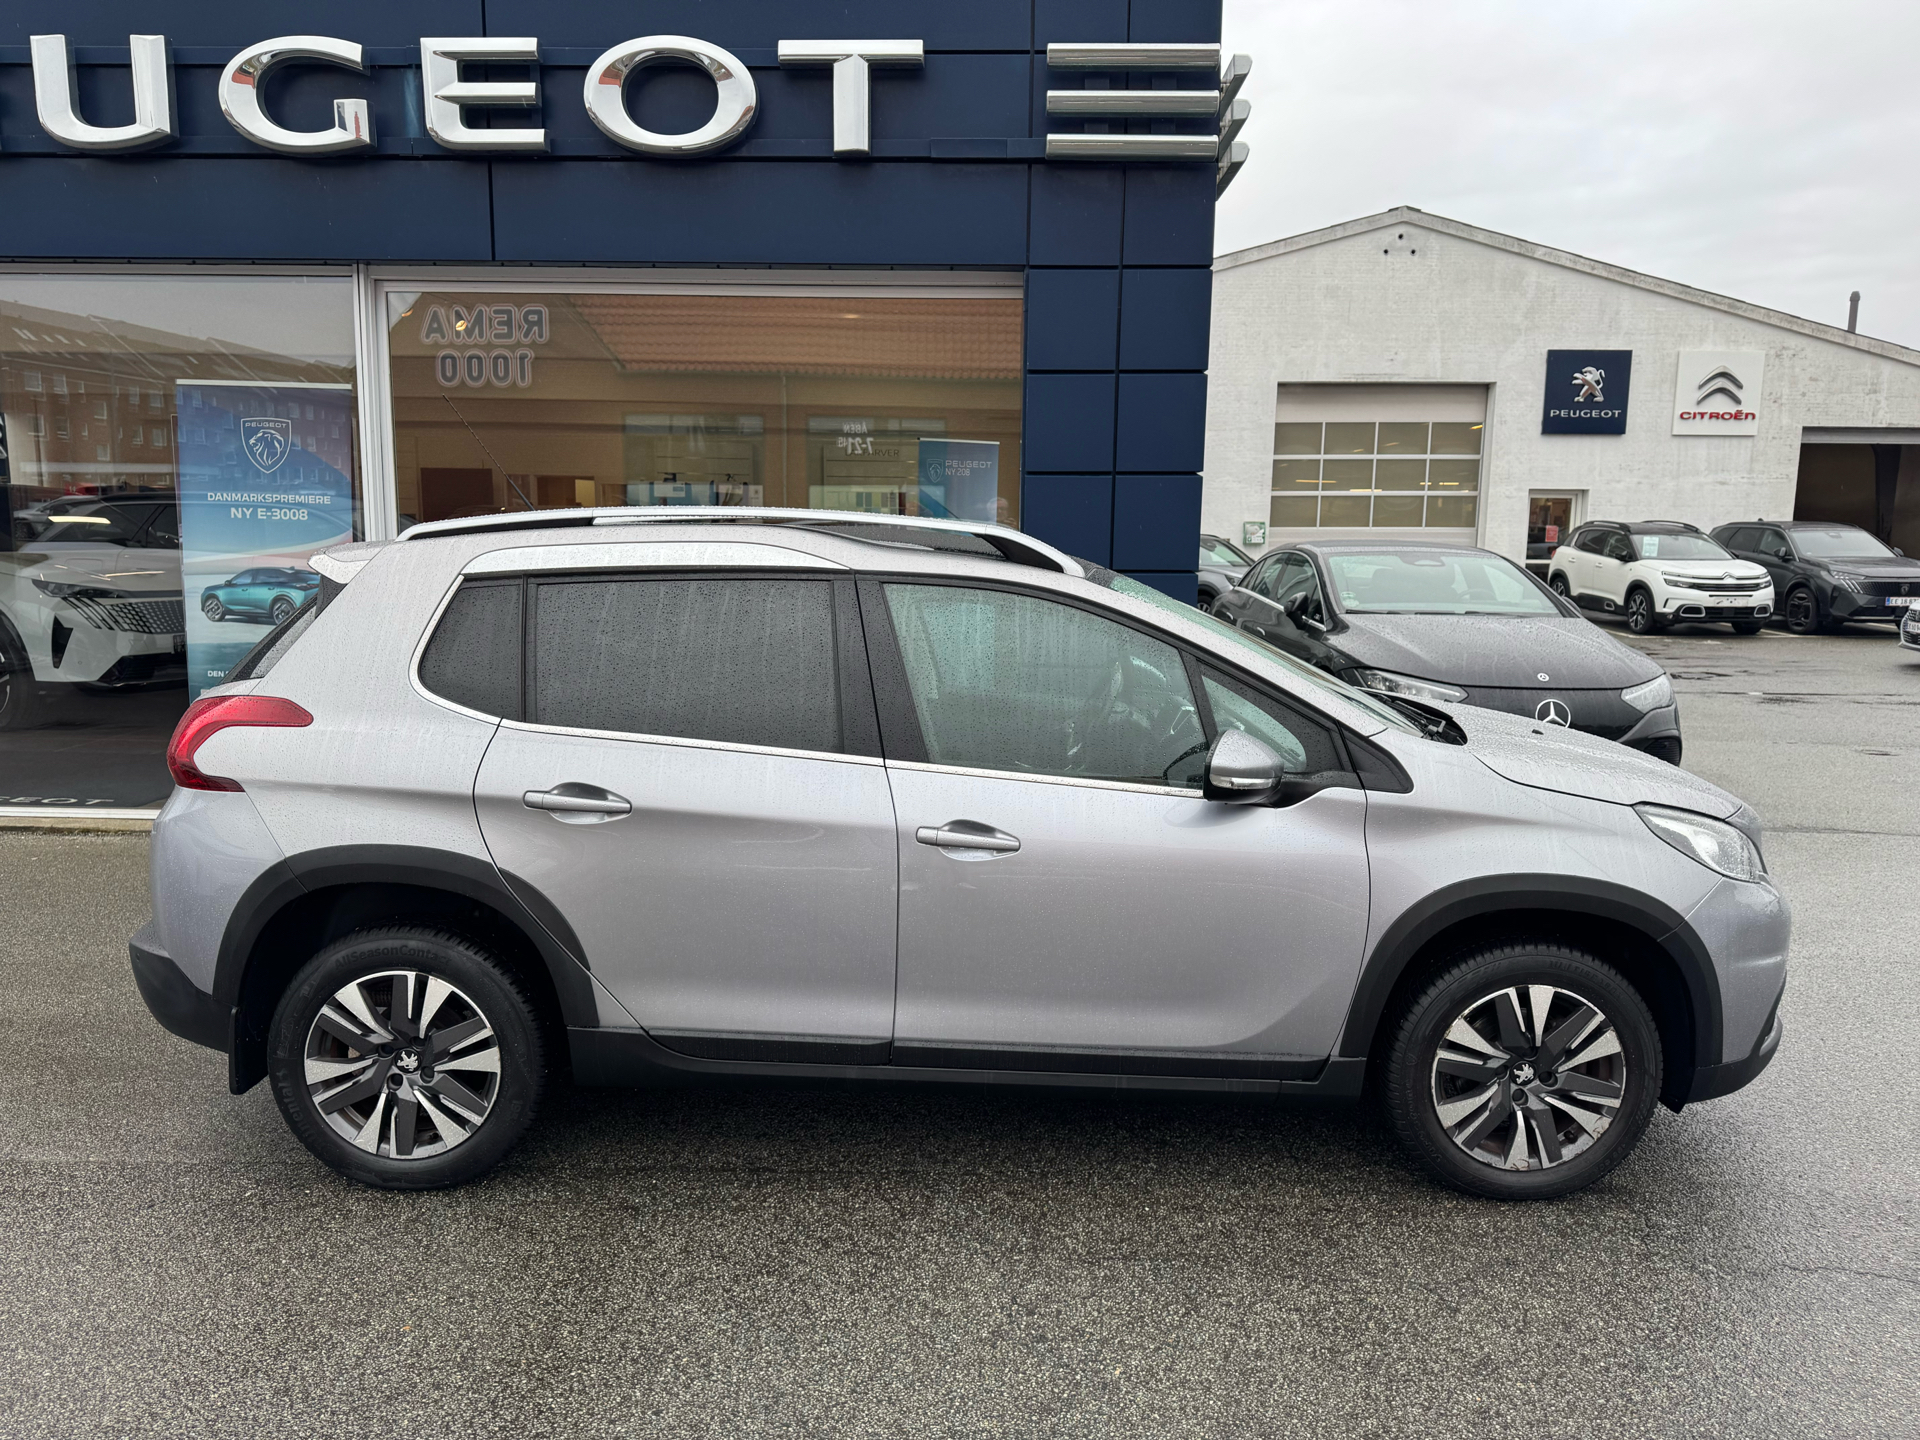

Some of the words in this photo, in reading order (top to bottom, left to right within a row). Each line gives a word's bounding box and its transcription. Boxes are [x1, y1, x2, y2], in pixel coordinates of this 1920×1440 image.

[0, 33, 925, 156] UGEOT
[1550, 409, 1622, 419] PEUGEOT
[945, 460, 992, 469] PEUGEOT
[945, 468, 956, 476] NY
[957, 468, 971, 476] 208
[207, 492, 331, 504] DANMARKSPREMIERE
[230, 507, 253, 519] NY
[257, 508, 308, 520] E-3008
[207, 670, 225, 678] DEN
